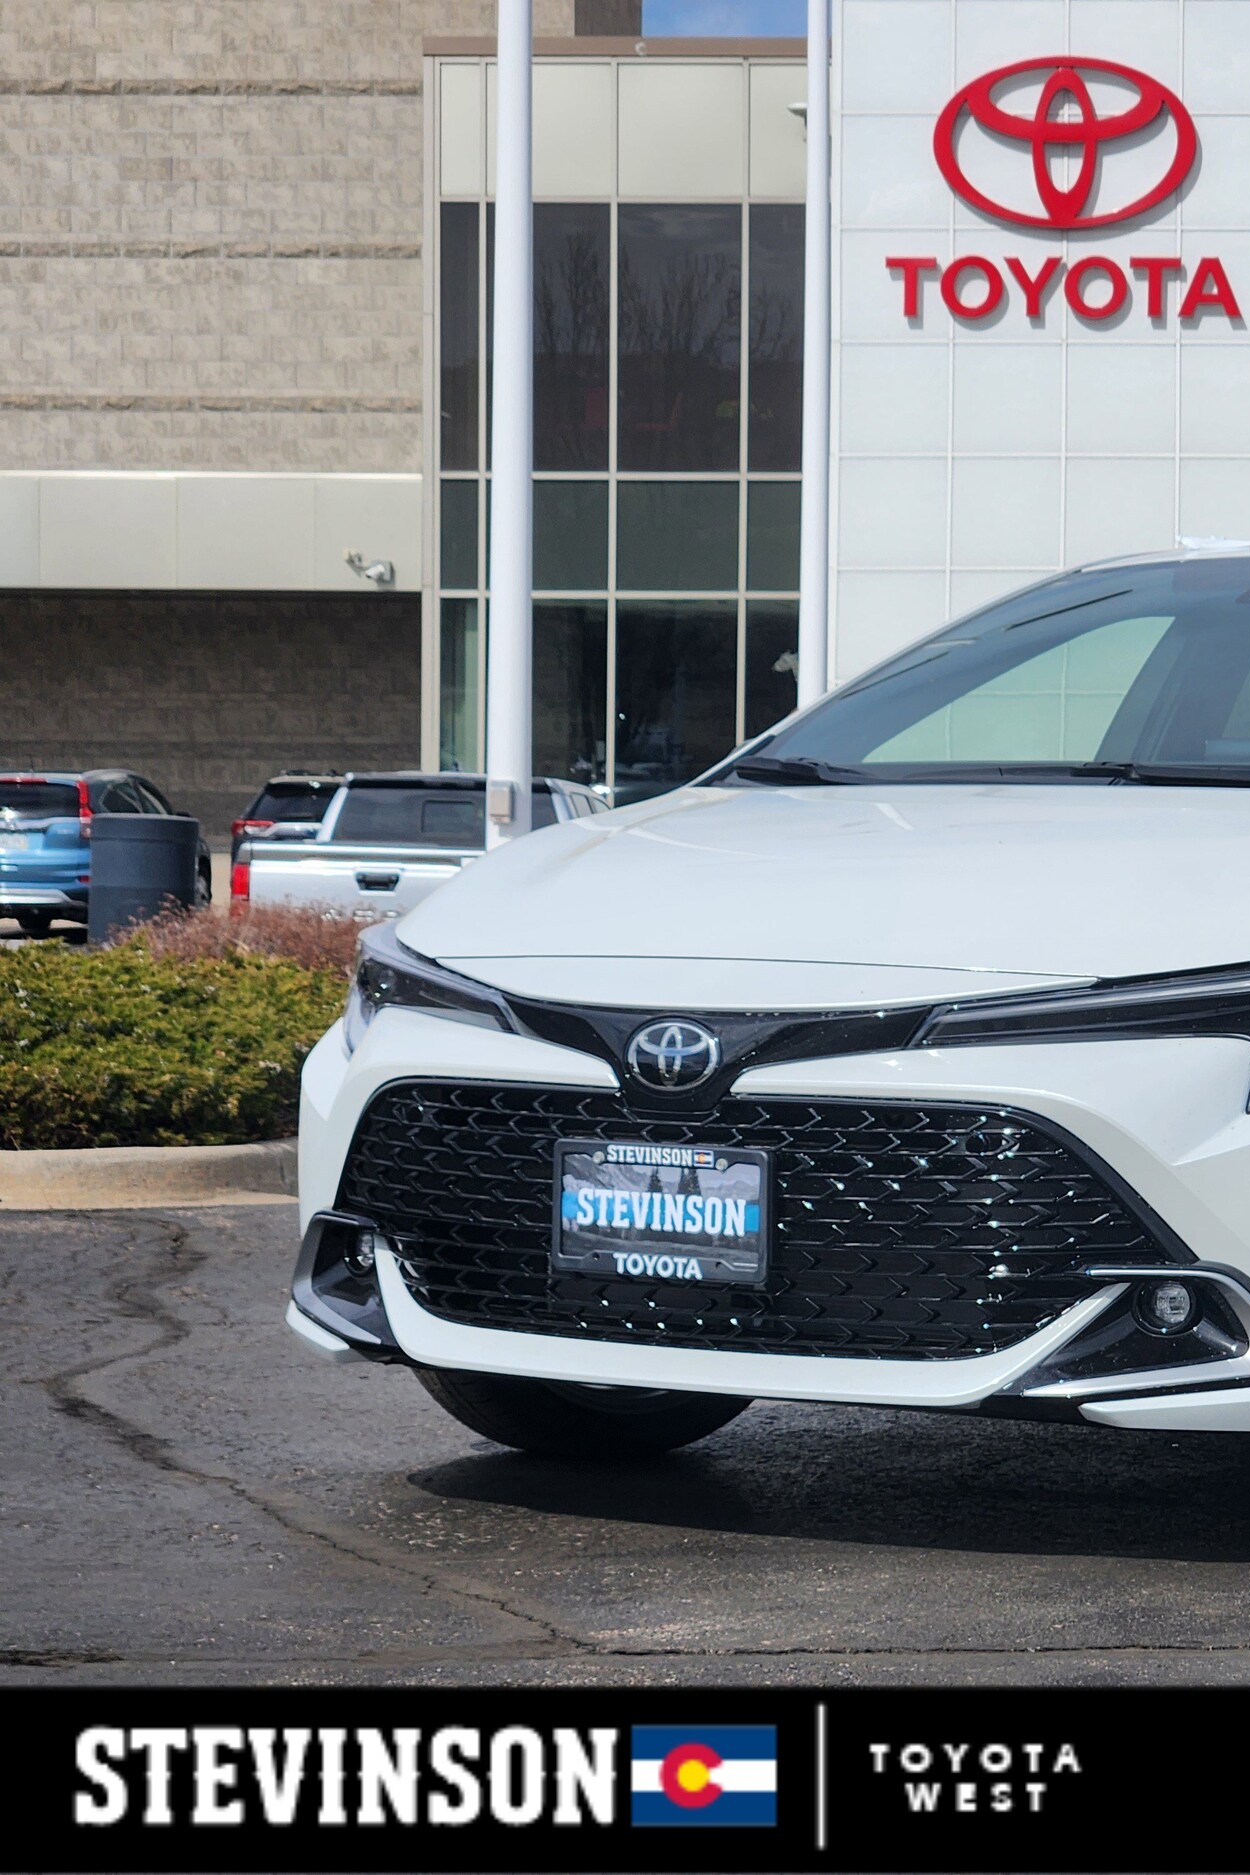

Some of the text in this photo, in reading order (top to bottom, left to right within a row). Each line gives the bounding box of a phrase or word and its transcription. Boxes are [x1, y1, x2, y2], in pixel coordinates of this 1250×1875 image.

[885, 256, 1241, 320] TOYOTA
[606, 1144, 693, 1166] STEVINSON
[576, 1187, 747, 1237] STEVINSON
[613, 1252, 703, 1280] TOYOTA
